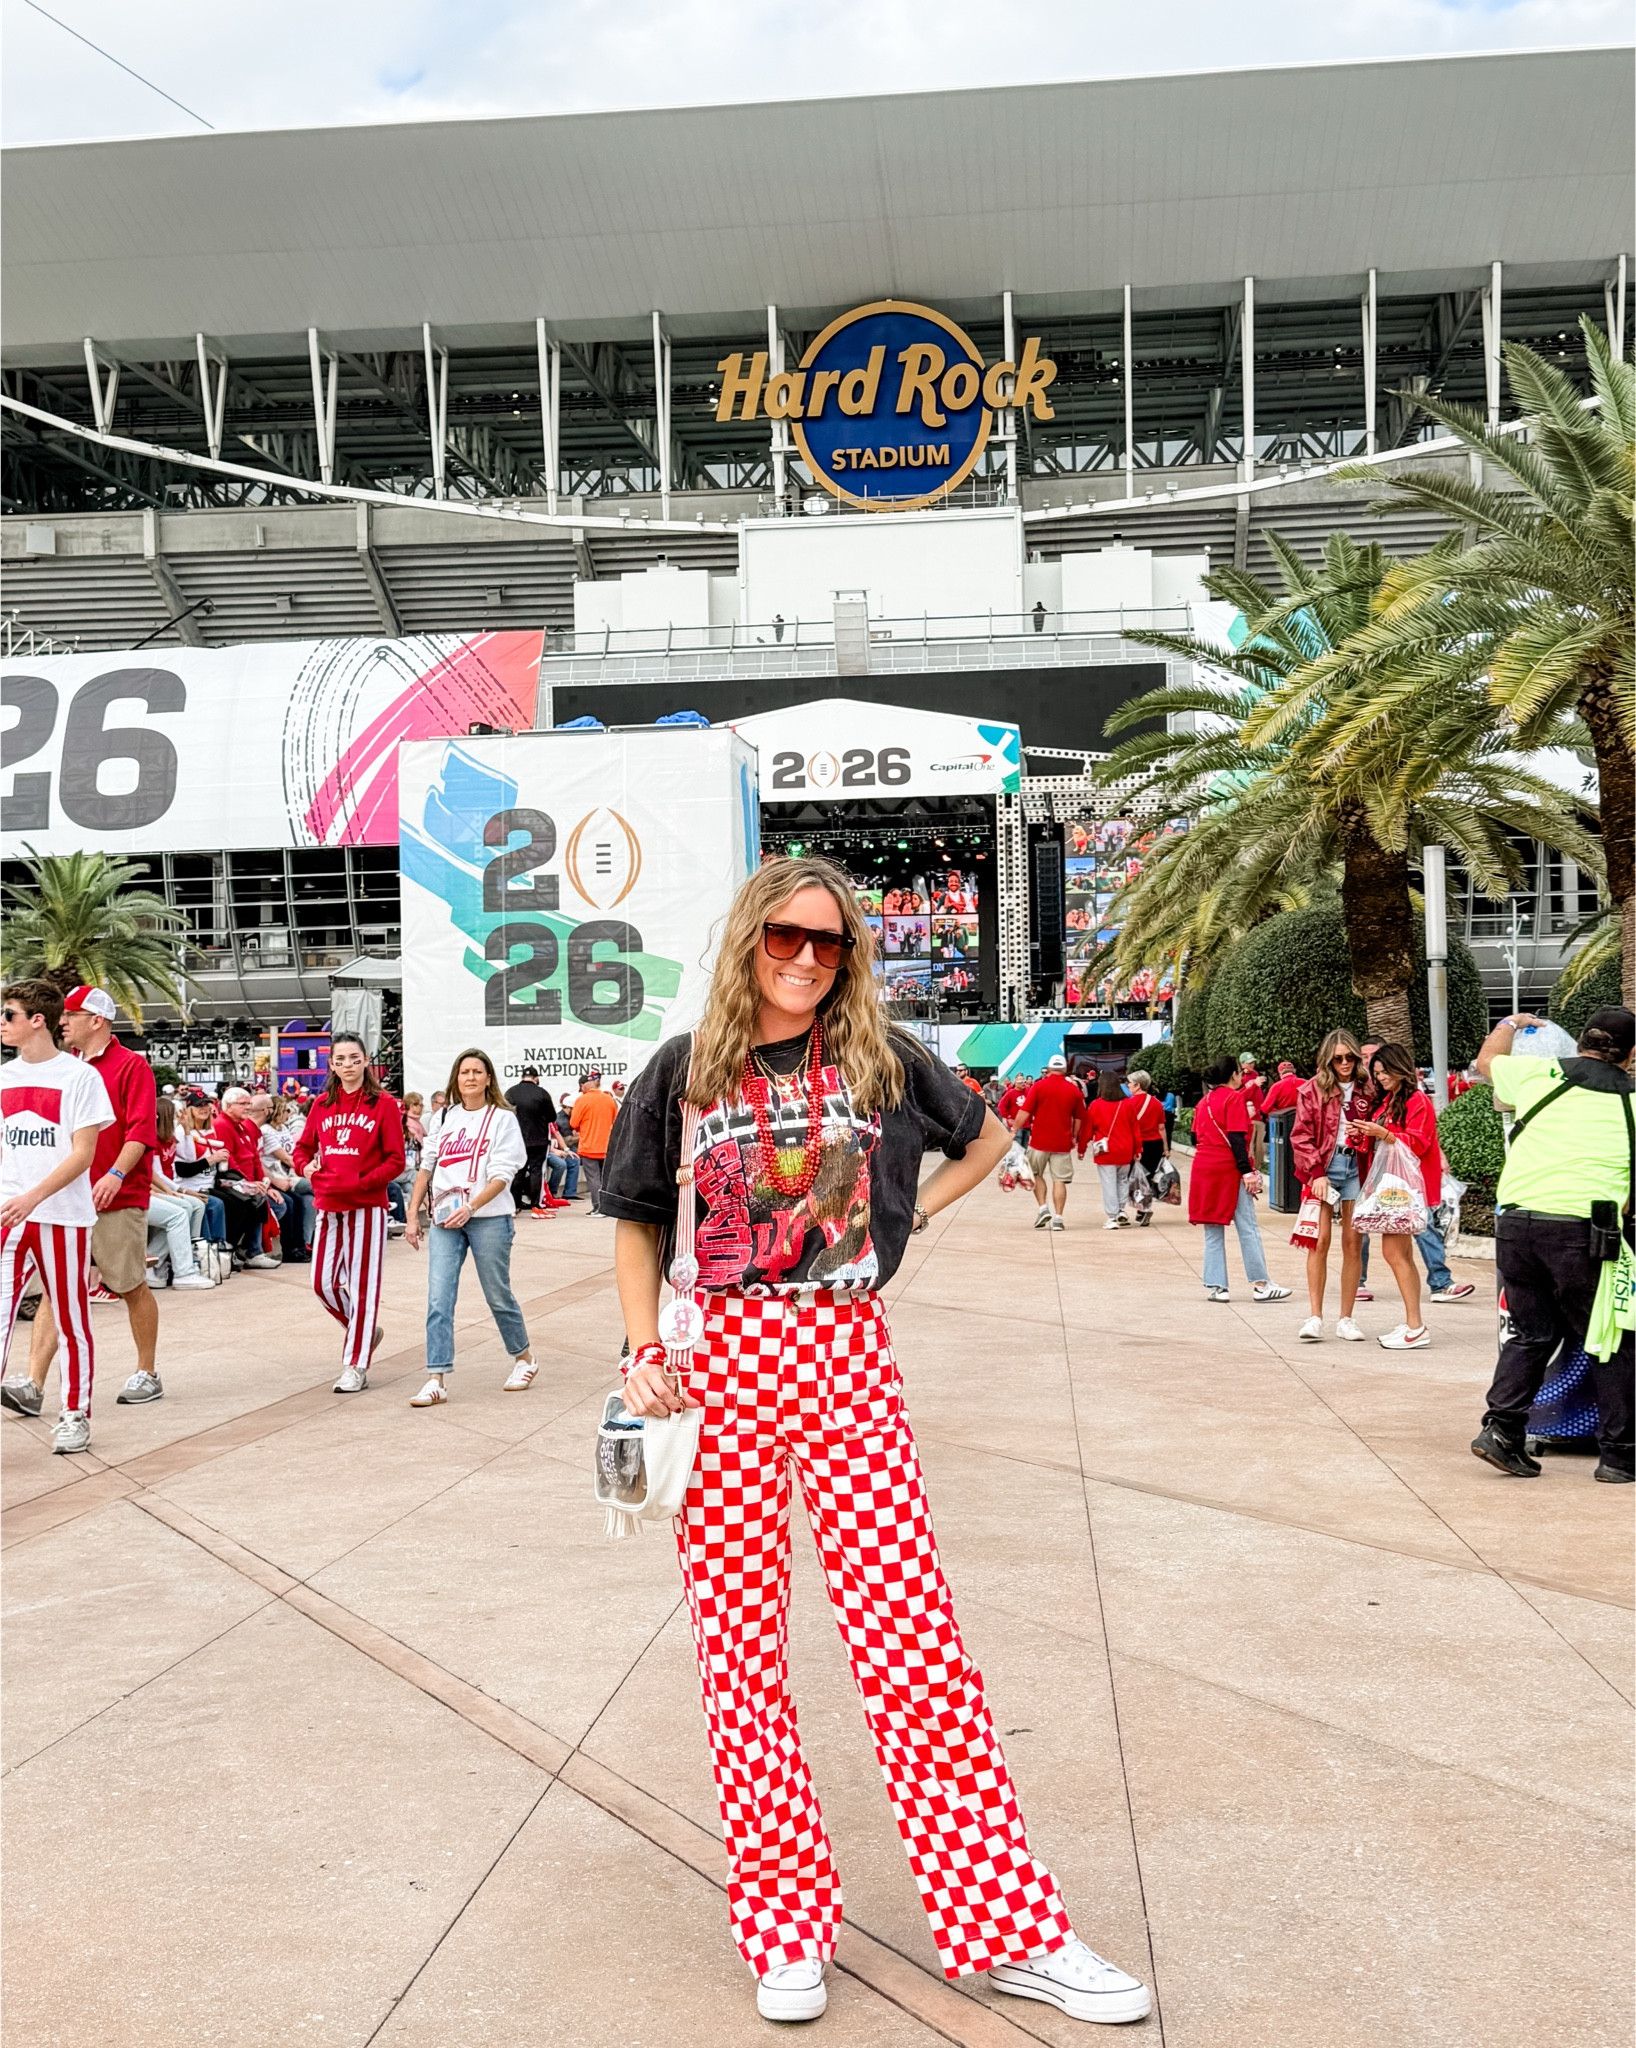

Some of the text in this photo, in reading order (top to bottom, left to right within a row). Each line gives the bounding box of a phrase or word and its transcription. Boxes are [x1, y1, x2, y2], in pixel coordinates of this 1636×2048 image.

[716, 337, 1058, 428] Hard Rock
[832, 444, 950, 471] STADIUM
[484, 919, 645, 1027] 26
[524, 1046, 607, 1061] NATIONAL
[321, 1112, 376, 1133] INDIANA
